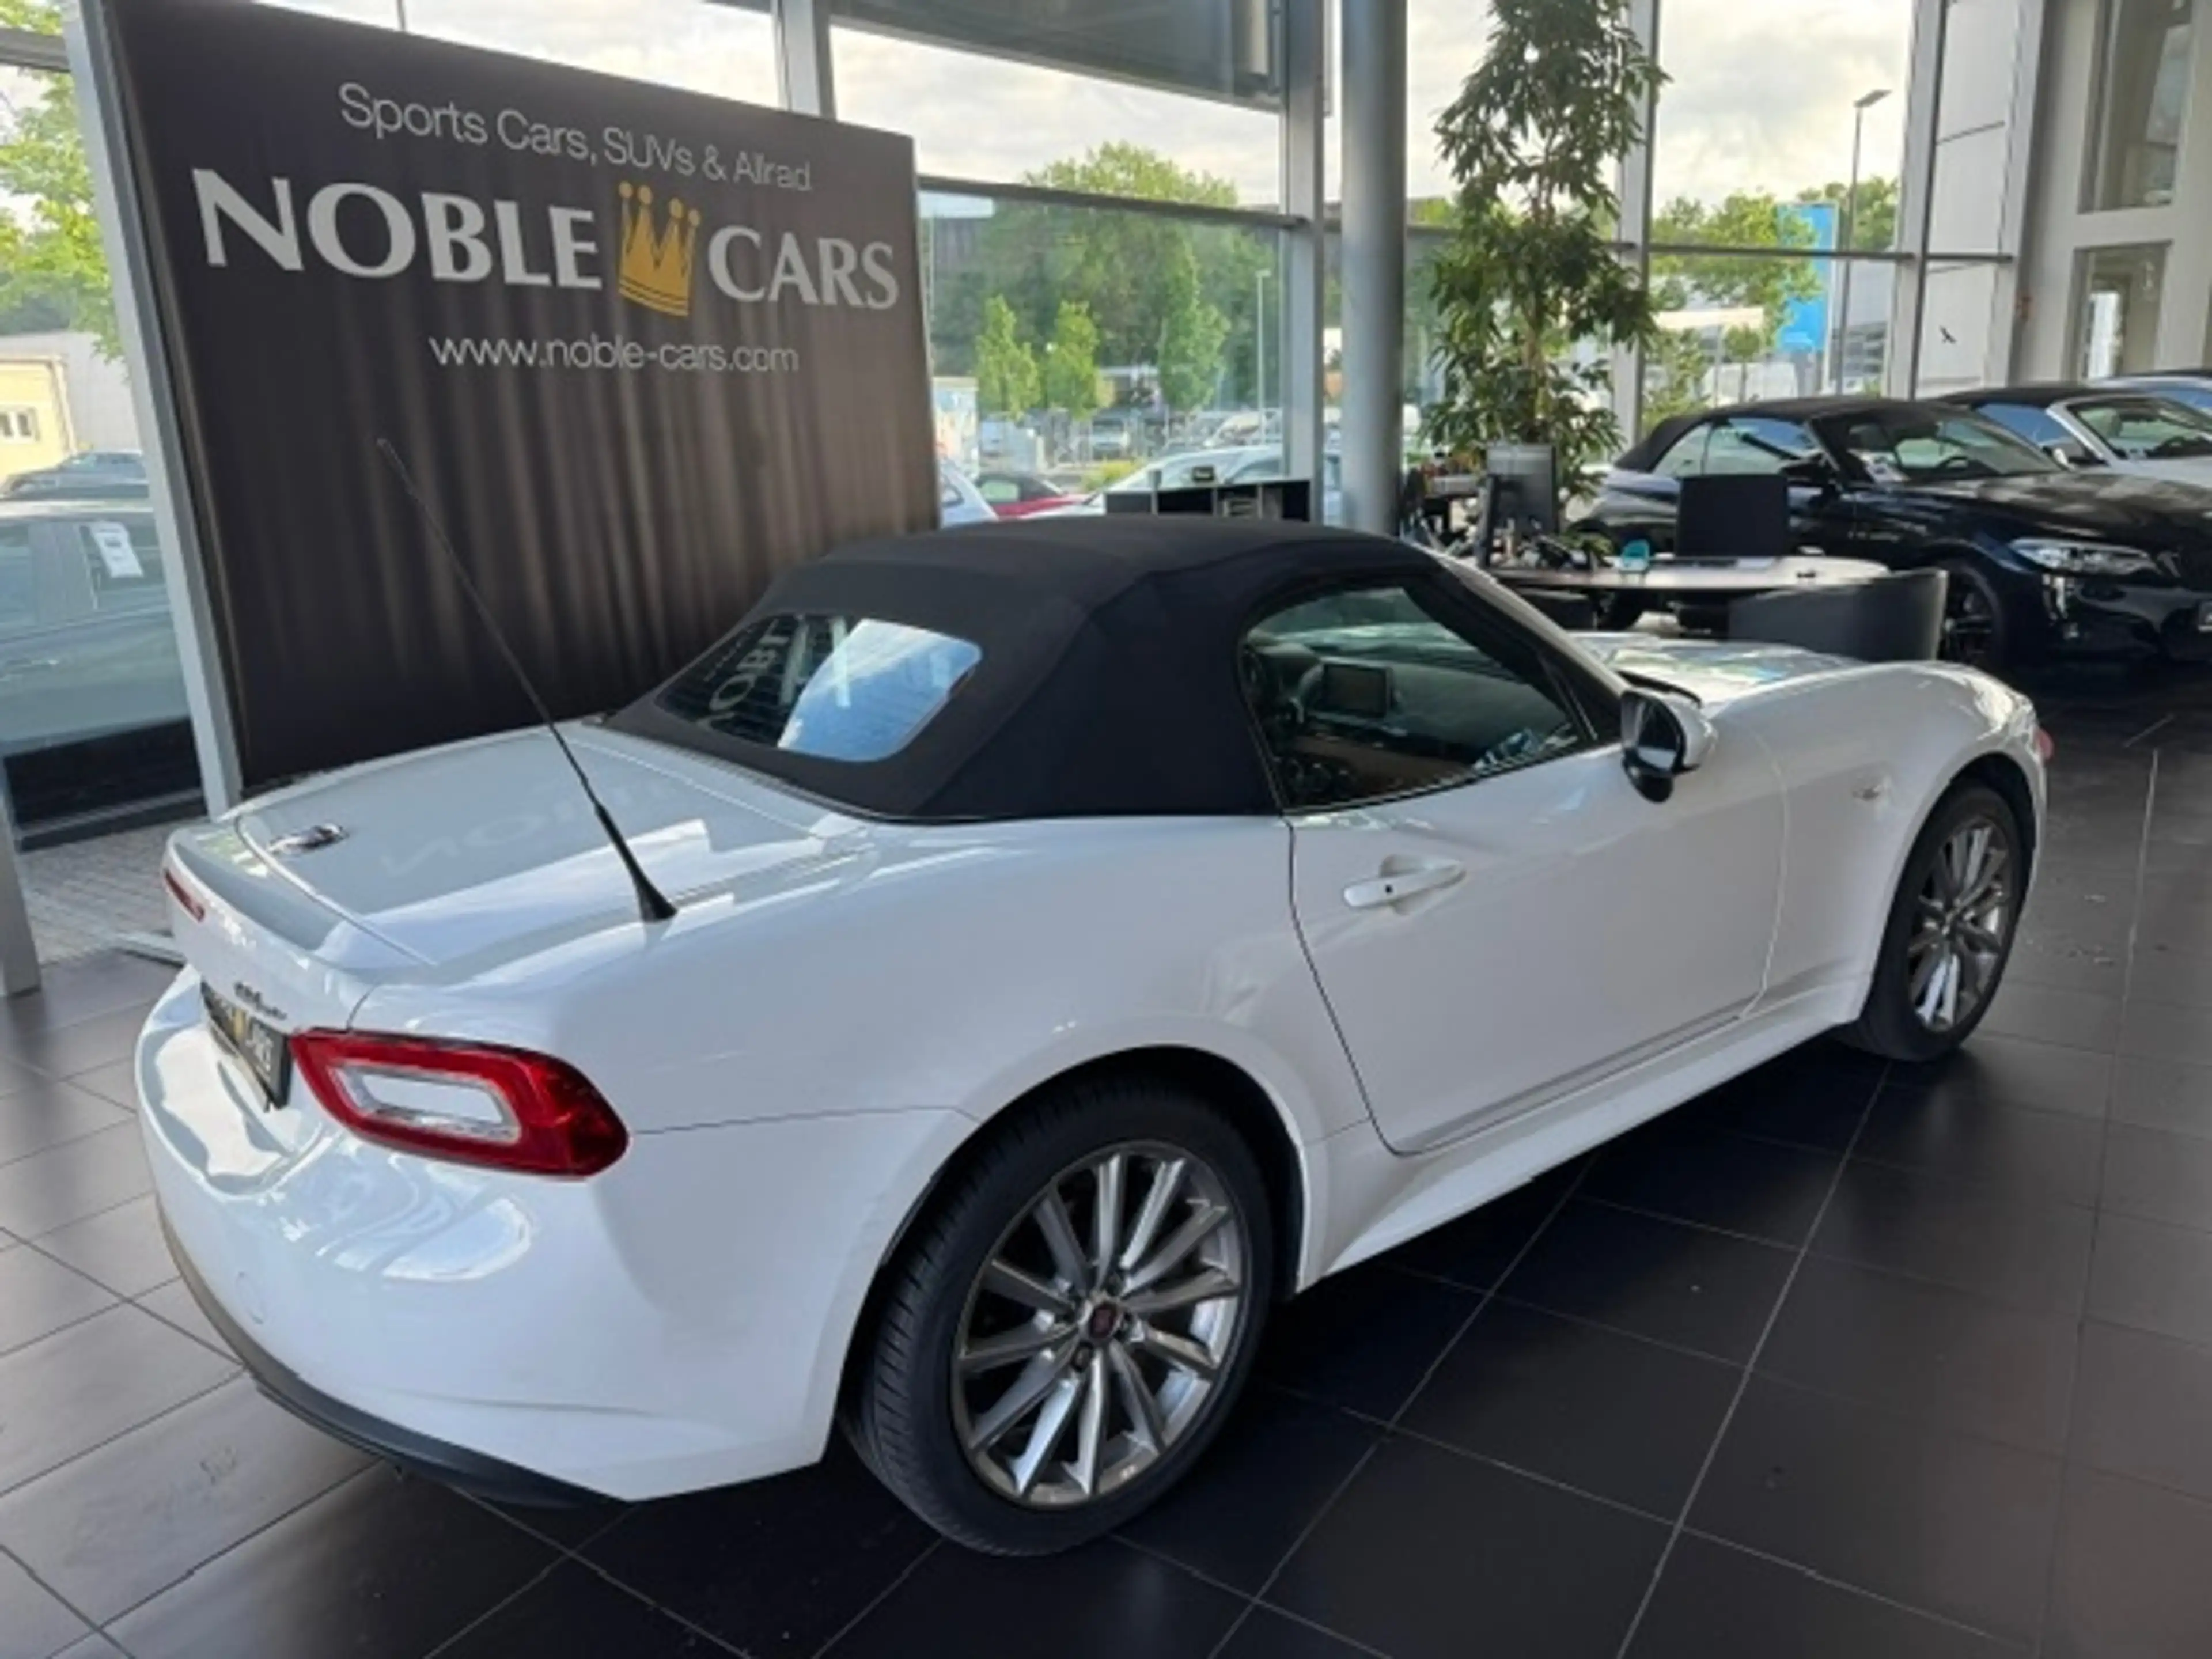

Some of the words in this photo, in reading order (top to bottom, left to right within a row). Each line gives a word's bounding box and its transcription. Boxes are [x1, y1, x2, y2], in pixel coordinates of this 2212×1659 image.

[338, 82, 488, 145] Sports
[497, 108, 598, 166] Cars,
[603, 126, 696, 176] SUVs
[701, 144, 726, 181] &
[192, 168, 603, 290] NOBLE
[707, 224, 900, 310] CARS
[428, 331, 799, 373] www.noble-cars.com
